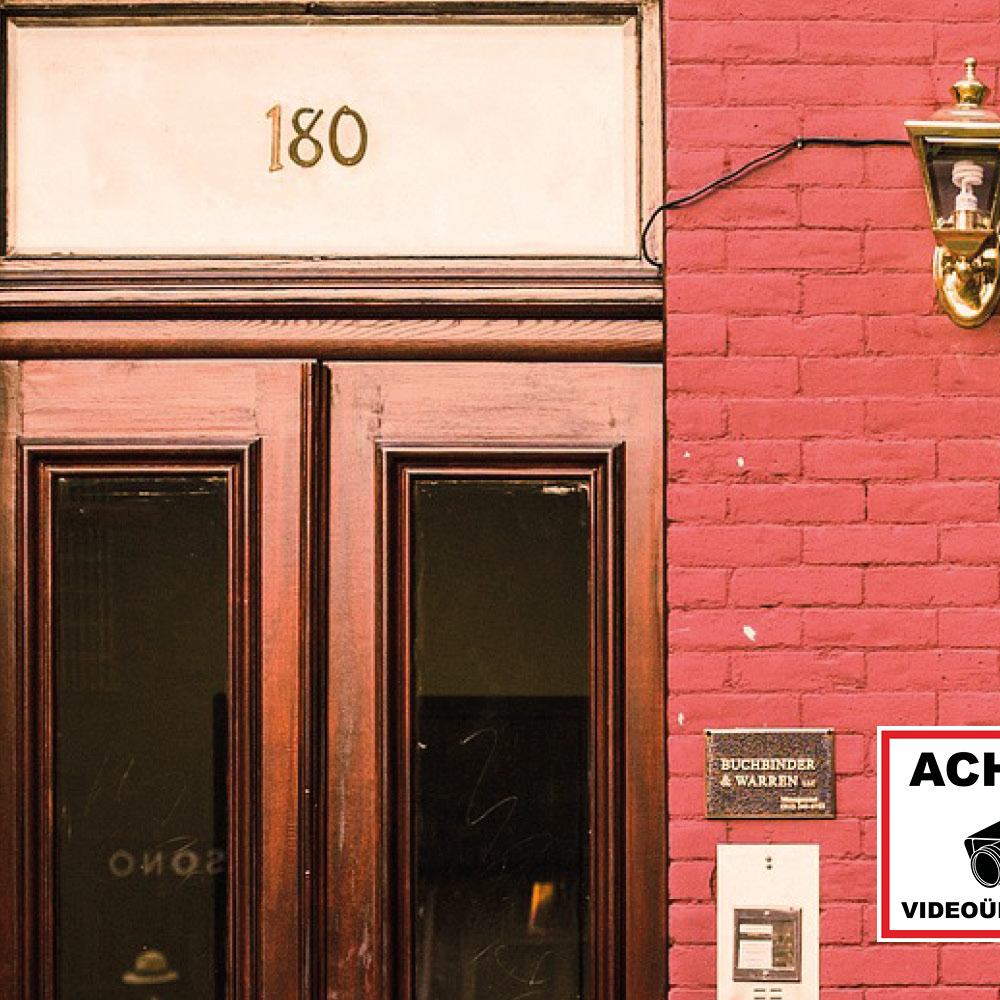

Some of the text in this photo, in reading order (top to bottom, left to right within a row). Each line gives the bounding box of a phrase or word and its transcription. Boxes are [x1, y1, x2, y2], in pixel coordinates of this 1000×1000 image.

[265, 104, 368, 172] 180
[720, 757, 816, 771] BUCHBINDER
[720, 774, 732, 787] &
[735, 775, 799, 787] WARREN
